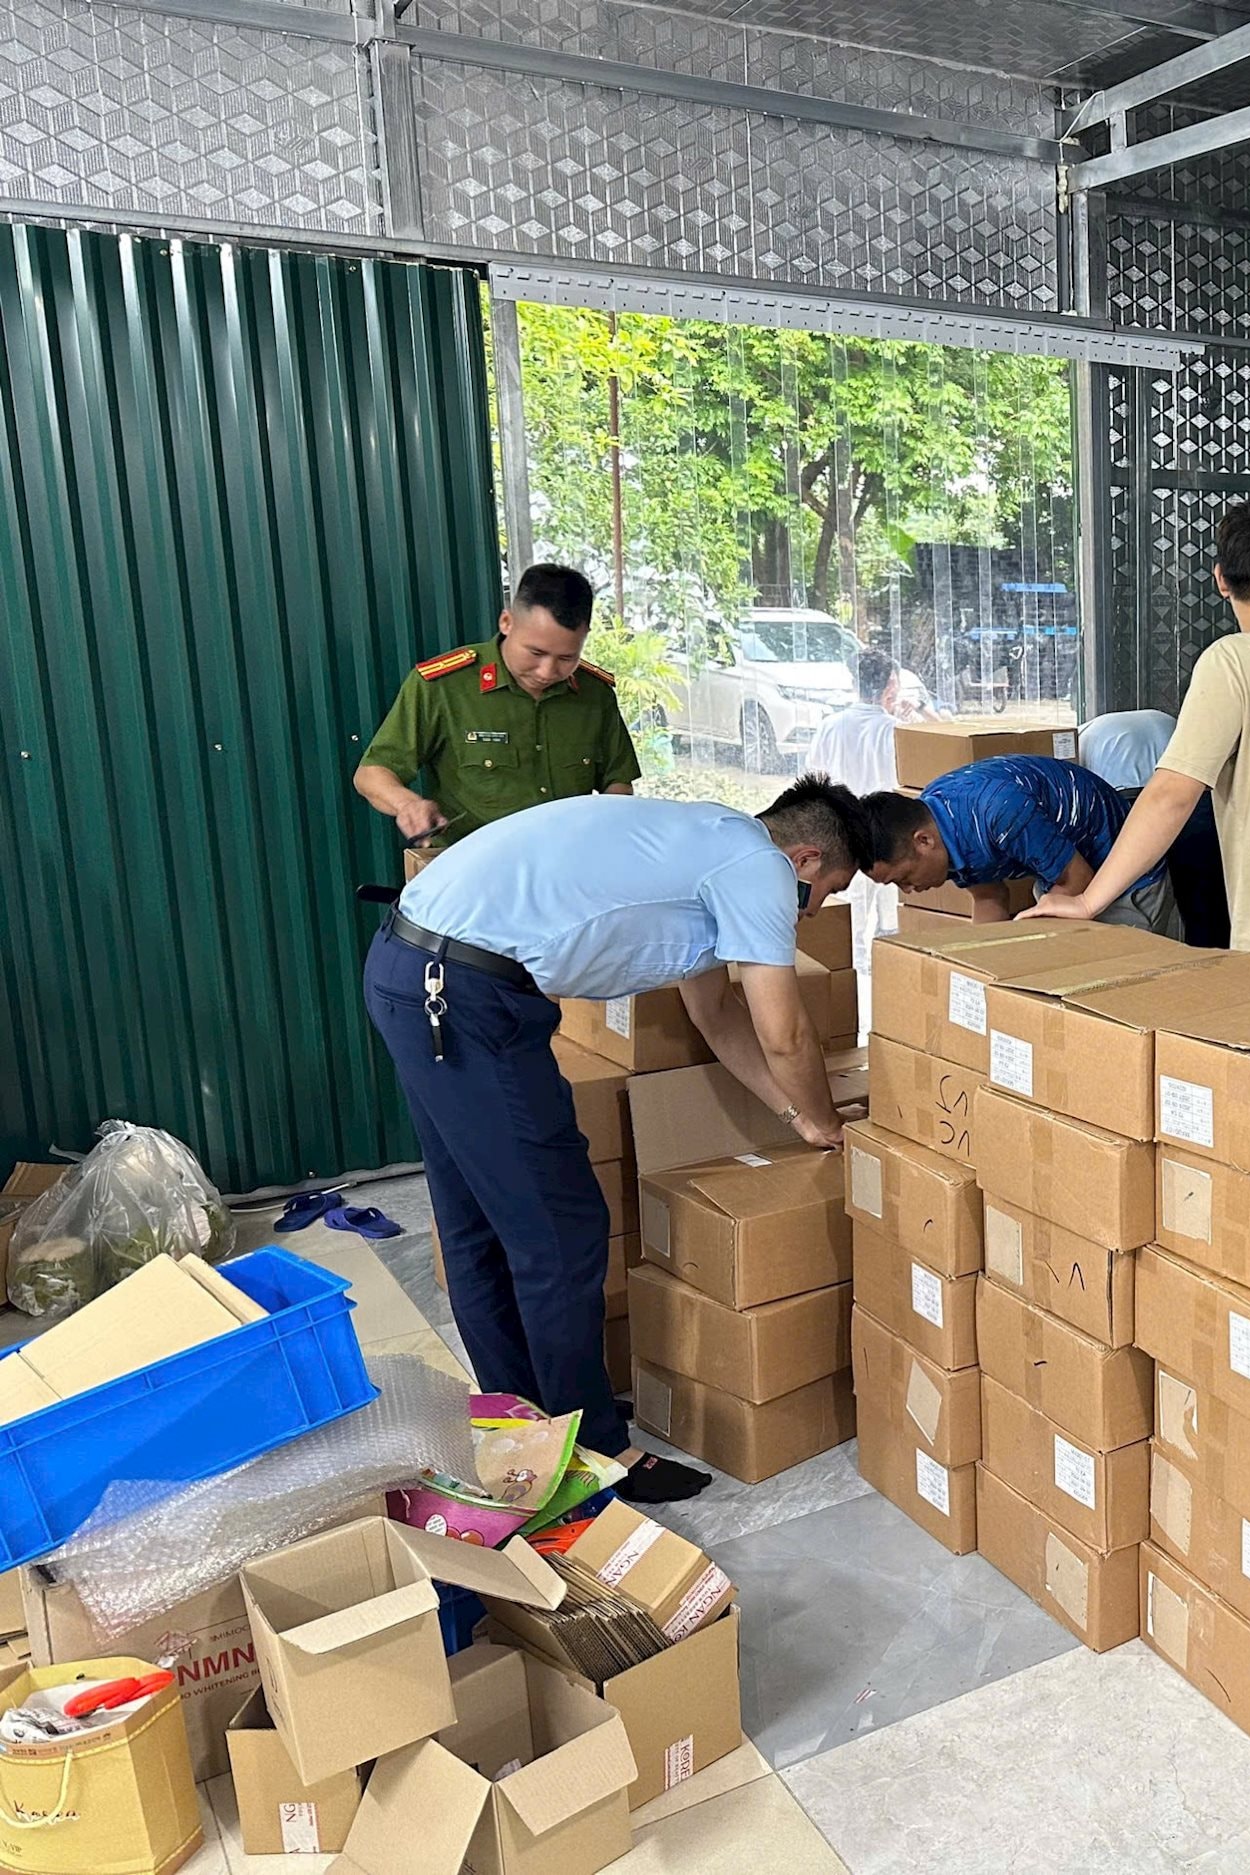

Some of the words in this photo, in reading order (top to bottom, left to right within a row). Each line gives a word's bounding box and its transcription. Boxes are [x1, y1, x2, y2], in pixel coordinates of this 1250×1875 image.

[177, 1642, 254, 1687] NMN
[193, 1672, 249, 1696] WHITENING
[680, 1744, 691, 1777] KORE
[283, 1803, 297, 1823] NG
